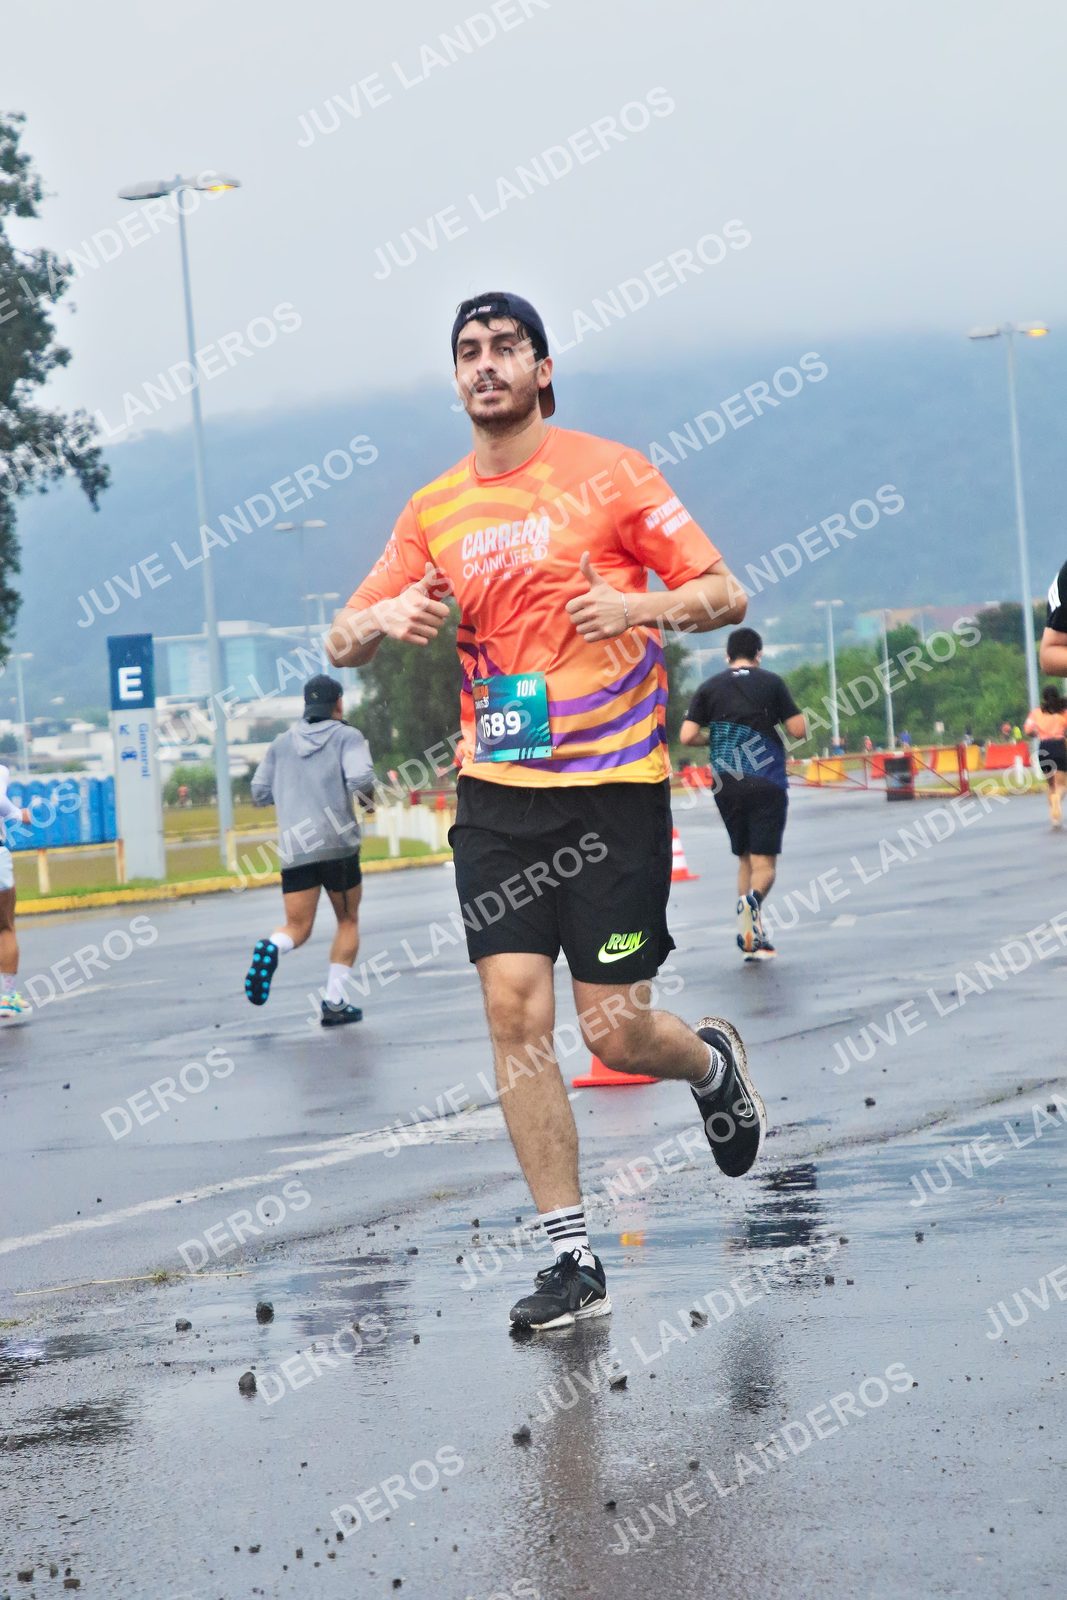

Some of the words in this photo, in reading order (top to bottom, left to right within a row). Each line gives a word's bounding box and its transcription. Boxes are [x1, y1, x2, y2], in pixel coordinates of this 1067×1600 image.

[463, 547, 529, 579] OMNILIFE
[118, 666, 144, 700] E
[516, 680, 537, 697] 10K
[606, 931, 643, 950] RUN
